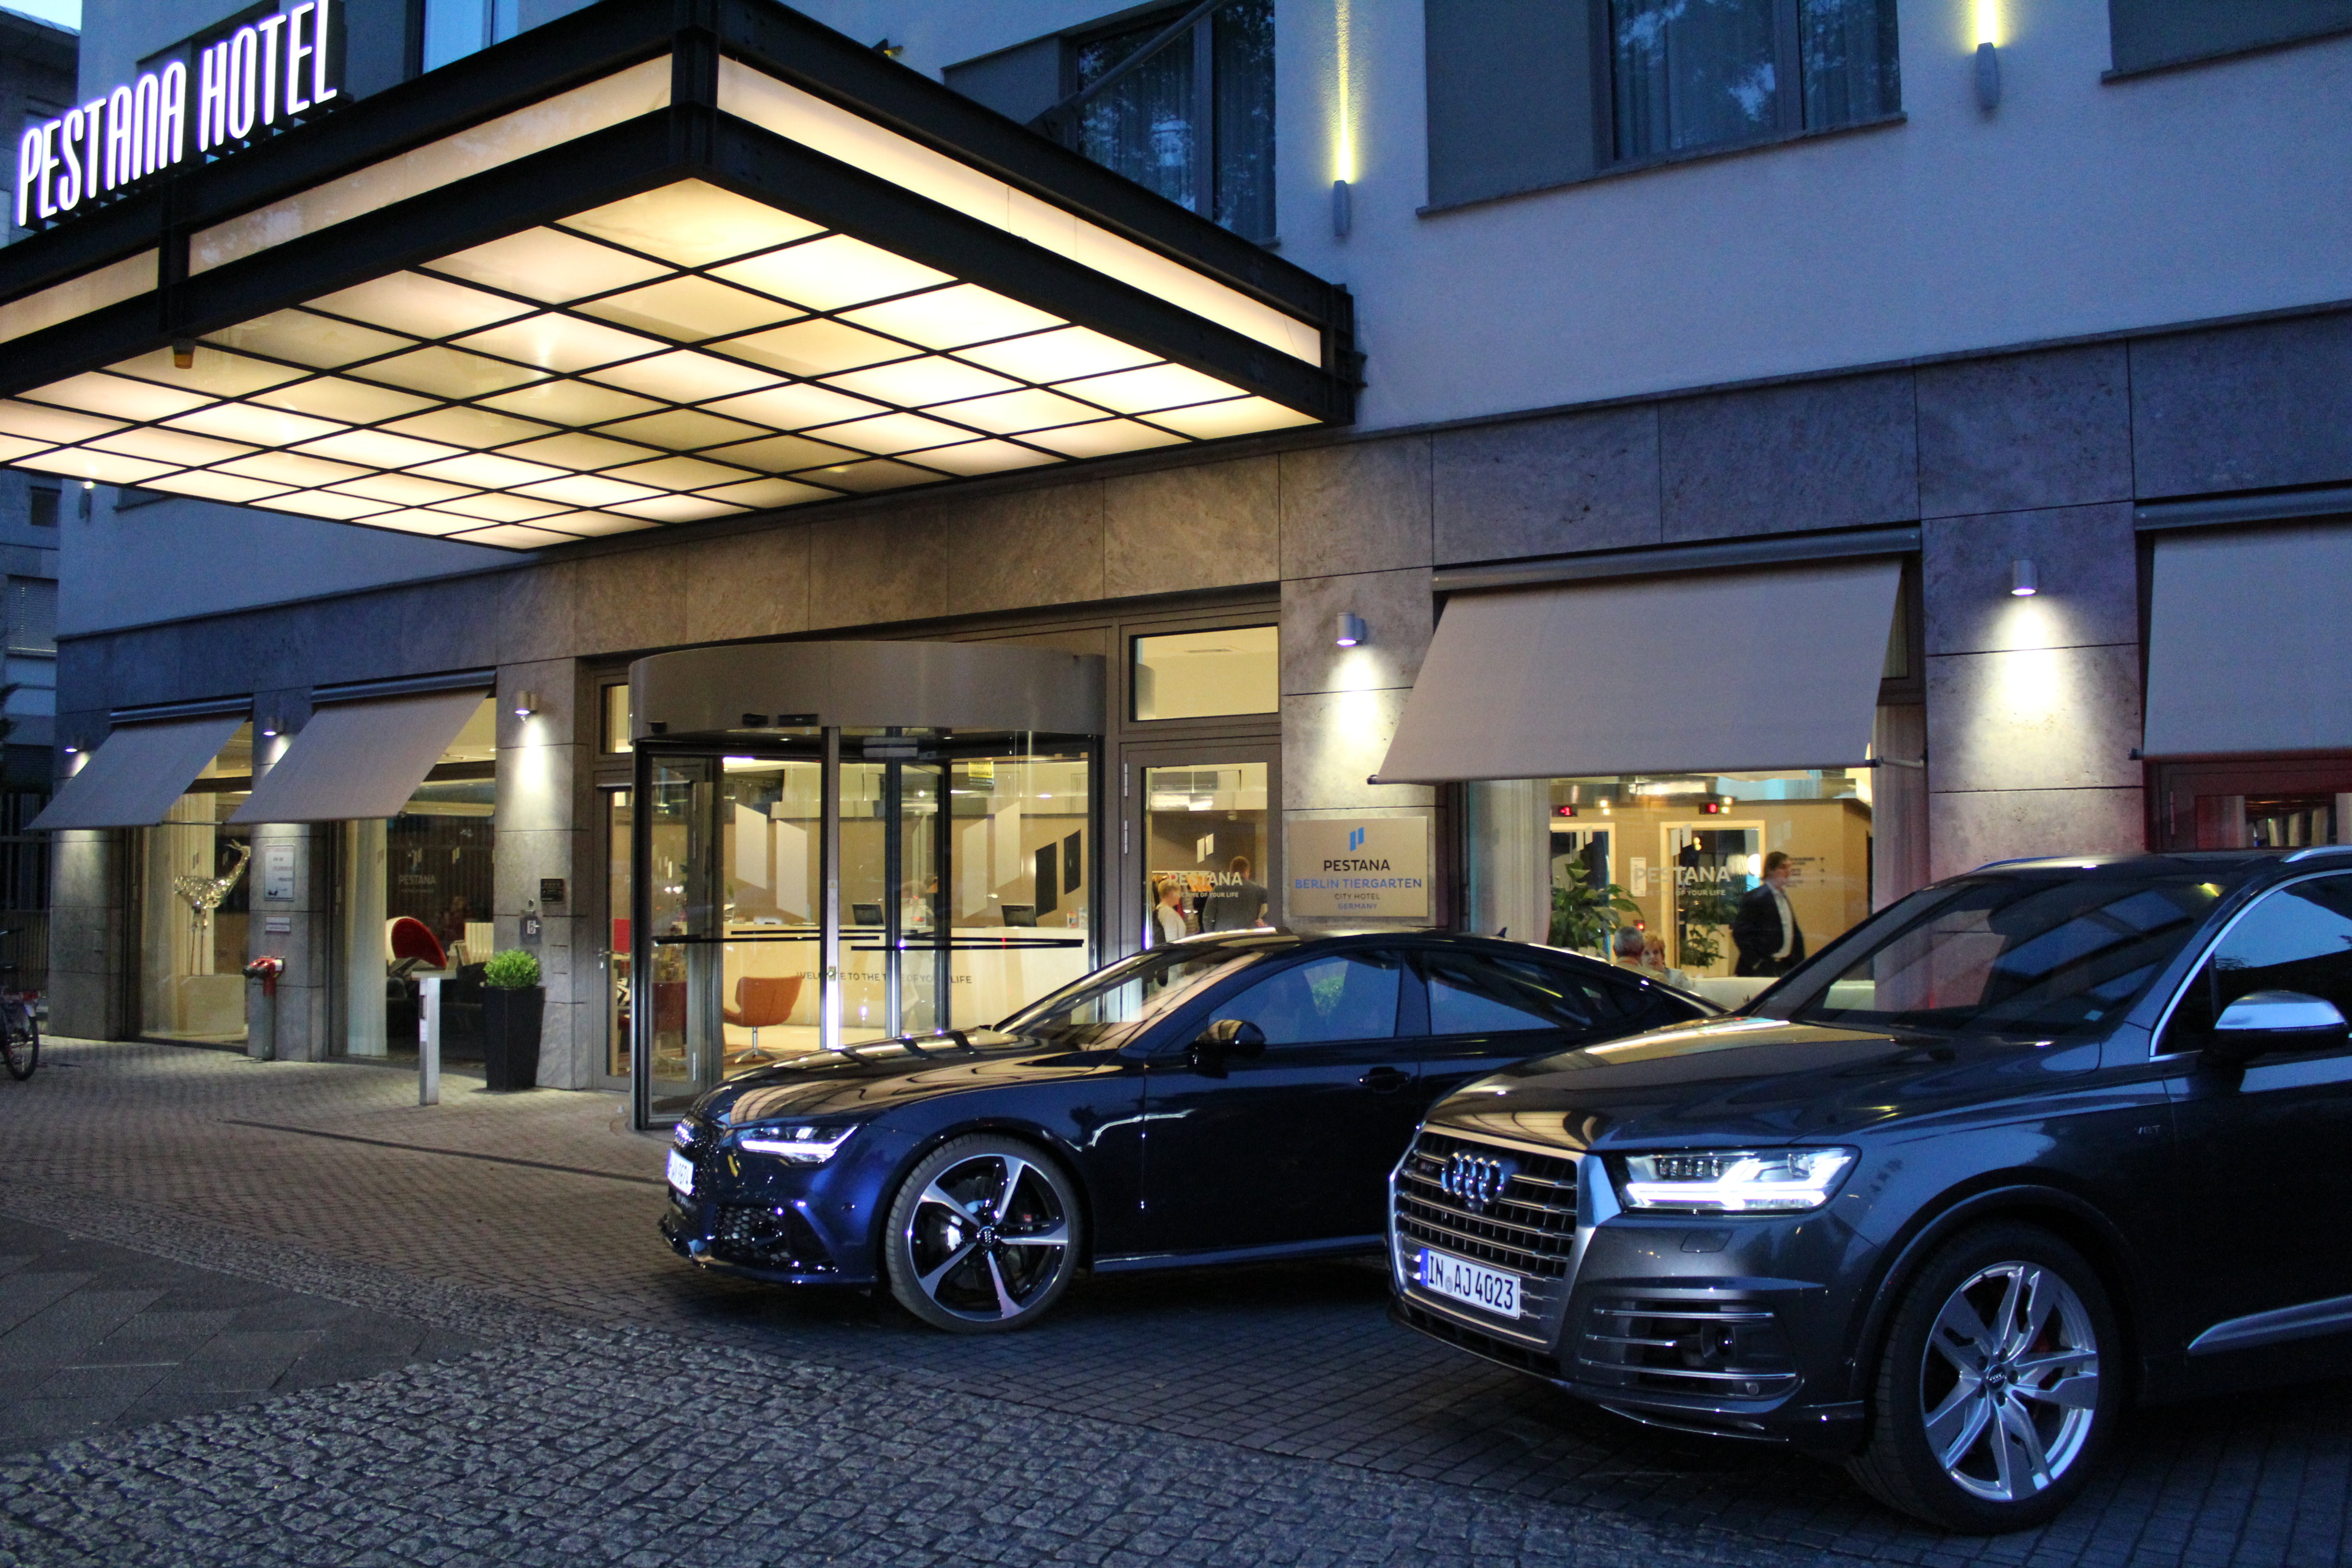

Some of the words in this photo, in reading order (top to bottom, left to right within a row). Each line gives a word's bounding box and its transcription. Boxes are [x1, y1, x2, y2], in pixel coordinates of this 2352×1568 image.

[17, 61, 186, 226] PESTANA
[201, 0, 338, 152] HOTEL
[1324, 859, 1390, 871] PESTANA
[1169, 872, 1243, 886] PESTANA
[1634, 866, 1731, 883] PESTANA
[1295, 879, 1338, 889] BERLIN
[1343, 878, 1422, 889] TIERGARTEN
[951, 975, 972, 984] LIFE
[1429, 1256, 1444, 1288] IN
